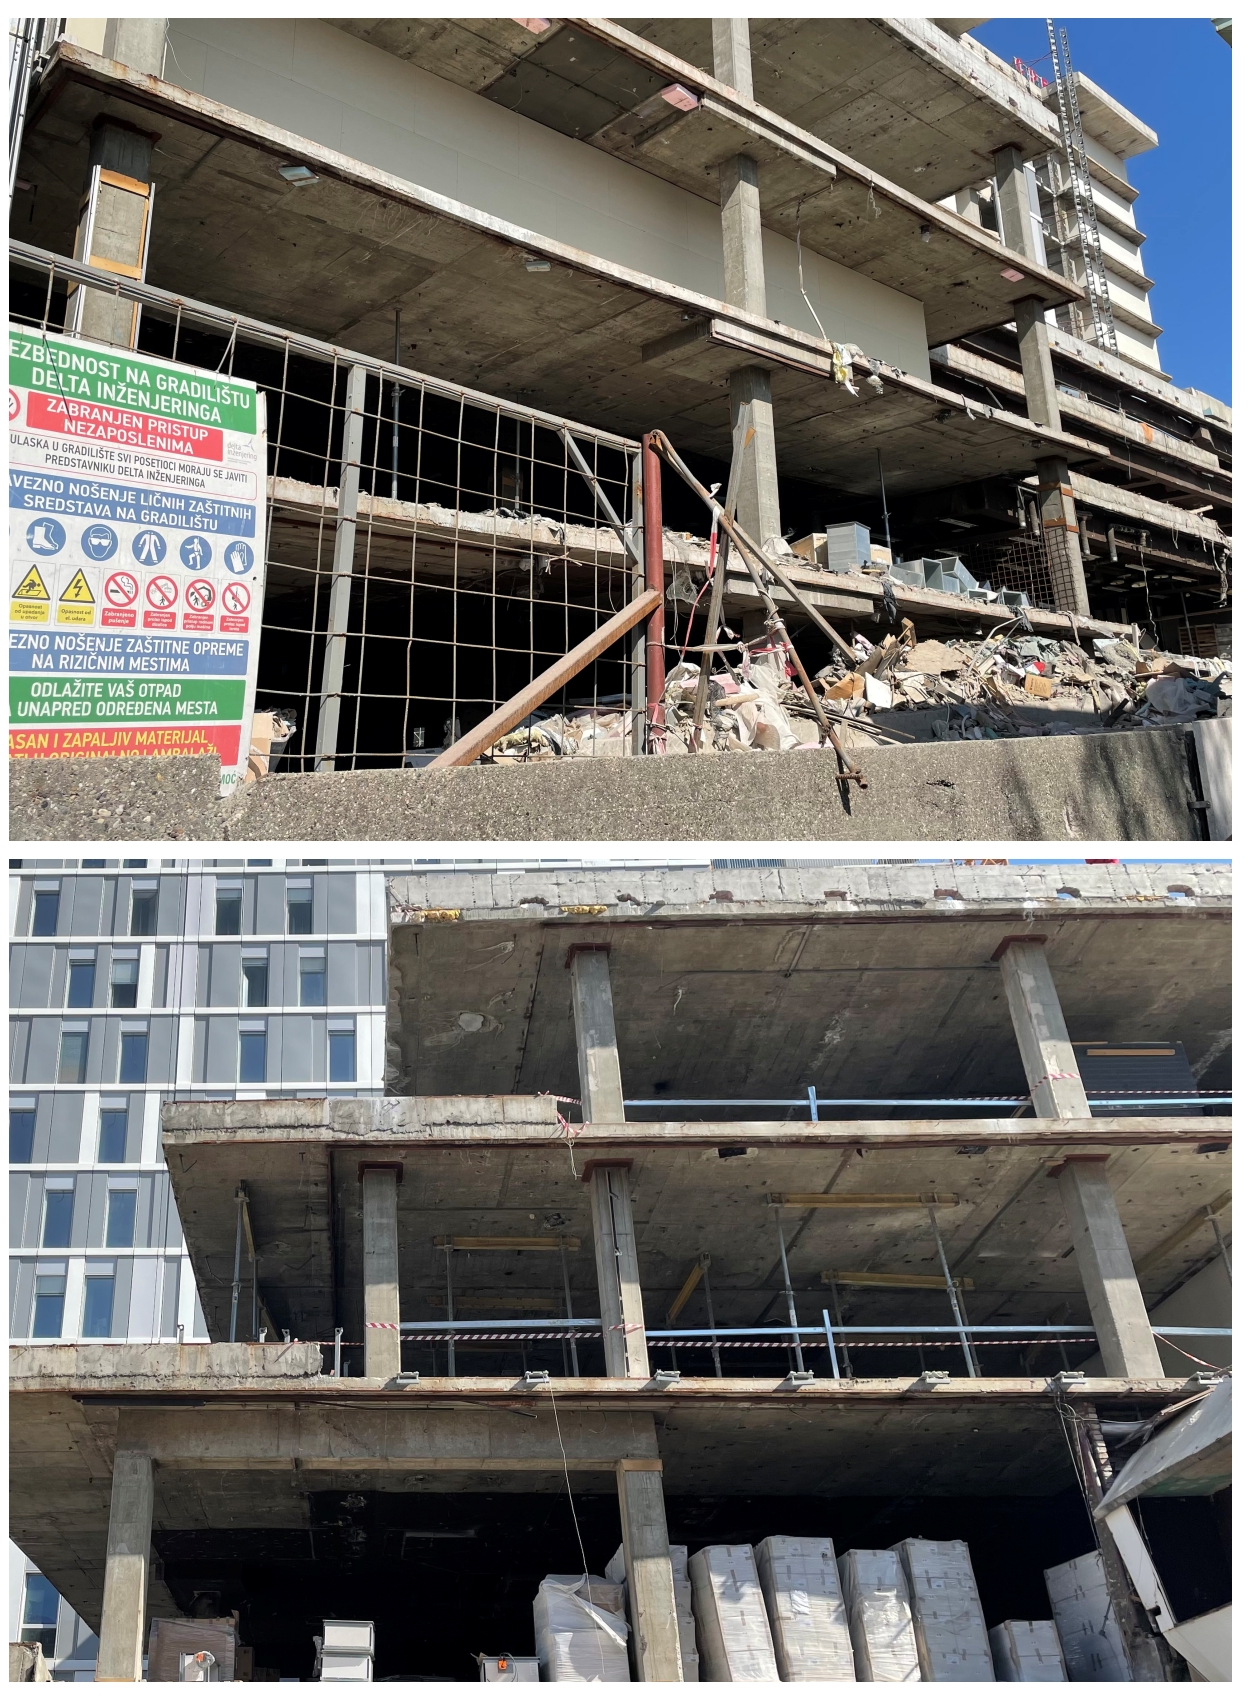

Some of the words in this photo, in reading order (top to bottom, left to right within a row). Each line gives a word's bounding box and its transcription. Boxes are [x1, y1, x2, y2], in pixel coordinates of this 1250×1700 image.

[9, 339, 120, 379] EZBEDNOST
[126, 366, 151, 387] NA
[156, 374, 250, 409] GRADILIŠTU
[32, 366, 90, 396] DELTA
[97, 381, 221, 424] INŽENJERINGA
[47, 398, 142, 429] ZABRANJEN
[148, 419, 208, 441] PRISTUP
[64, 419, 193, 455] NEZAPOSLENIMA
[10, 434, 49, 450] ULASKA
[52, 441, 59, 451] U
[62, 443, 115, 461] GRADILIŠTE
[117, 453, 132, 464] SVI
[134, 455, 176, 471] POSETIOCI
[178, 463, 211, 477] MORAJU
[213, 469, 223, 480] SE
[224, 471, 248, 483] JAVITI
[45, 453, 115, 474] PREDSTAVNIKU
[118, 465, 144, 479] DELTA
[146, 470, 205, 488] INŽENJERINGA
[23, 494, 111, 517] SREDSTAVA
[116, 506, 136, 521] NA
[140, 510, 218, 531] GRADILIŠTU
[69, 482, 136, 504] NOŠENJE
[140, 492, 185, 511] LIČNIH
[189, 500, 252, 520] ZAŠTITNIH
[9, 633, 50, 649] EZNO
[54, 632, 123, 653] NOŠENJE
[126, 635, 190, 655] ZAŠTITNE
[193, 641, 244, 656] OPREME
[31, 653, 54, 669] NA
[59, 651, 125, 671] RIZIČNIM
[129, 656, 190, 672] MESTIMA
[30, 678, 104, 698] ODLAŽITE
[107, 679, 135, 698] VAŠ
[138, 683, 182, 698] OTPAD
[17, 701, 91, 717] UNAPRED
[96, 701, 172, 716] ODREĐENA
[175, 701, 218, 715] MESTA
[53, 733, 59, 748] I
[62, 731, 132, 748] ZAPALJIV
[135, 729, 208, 746] MATERIJAL
